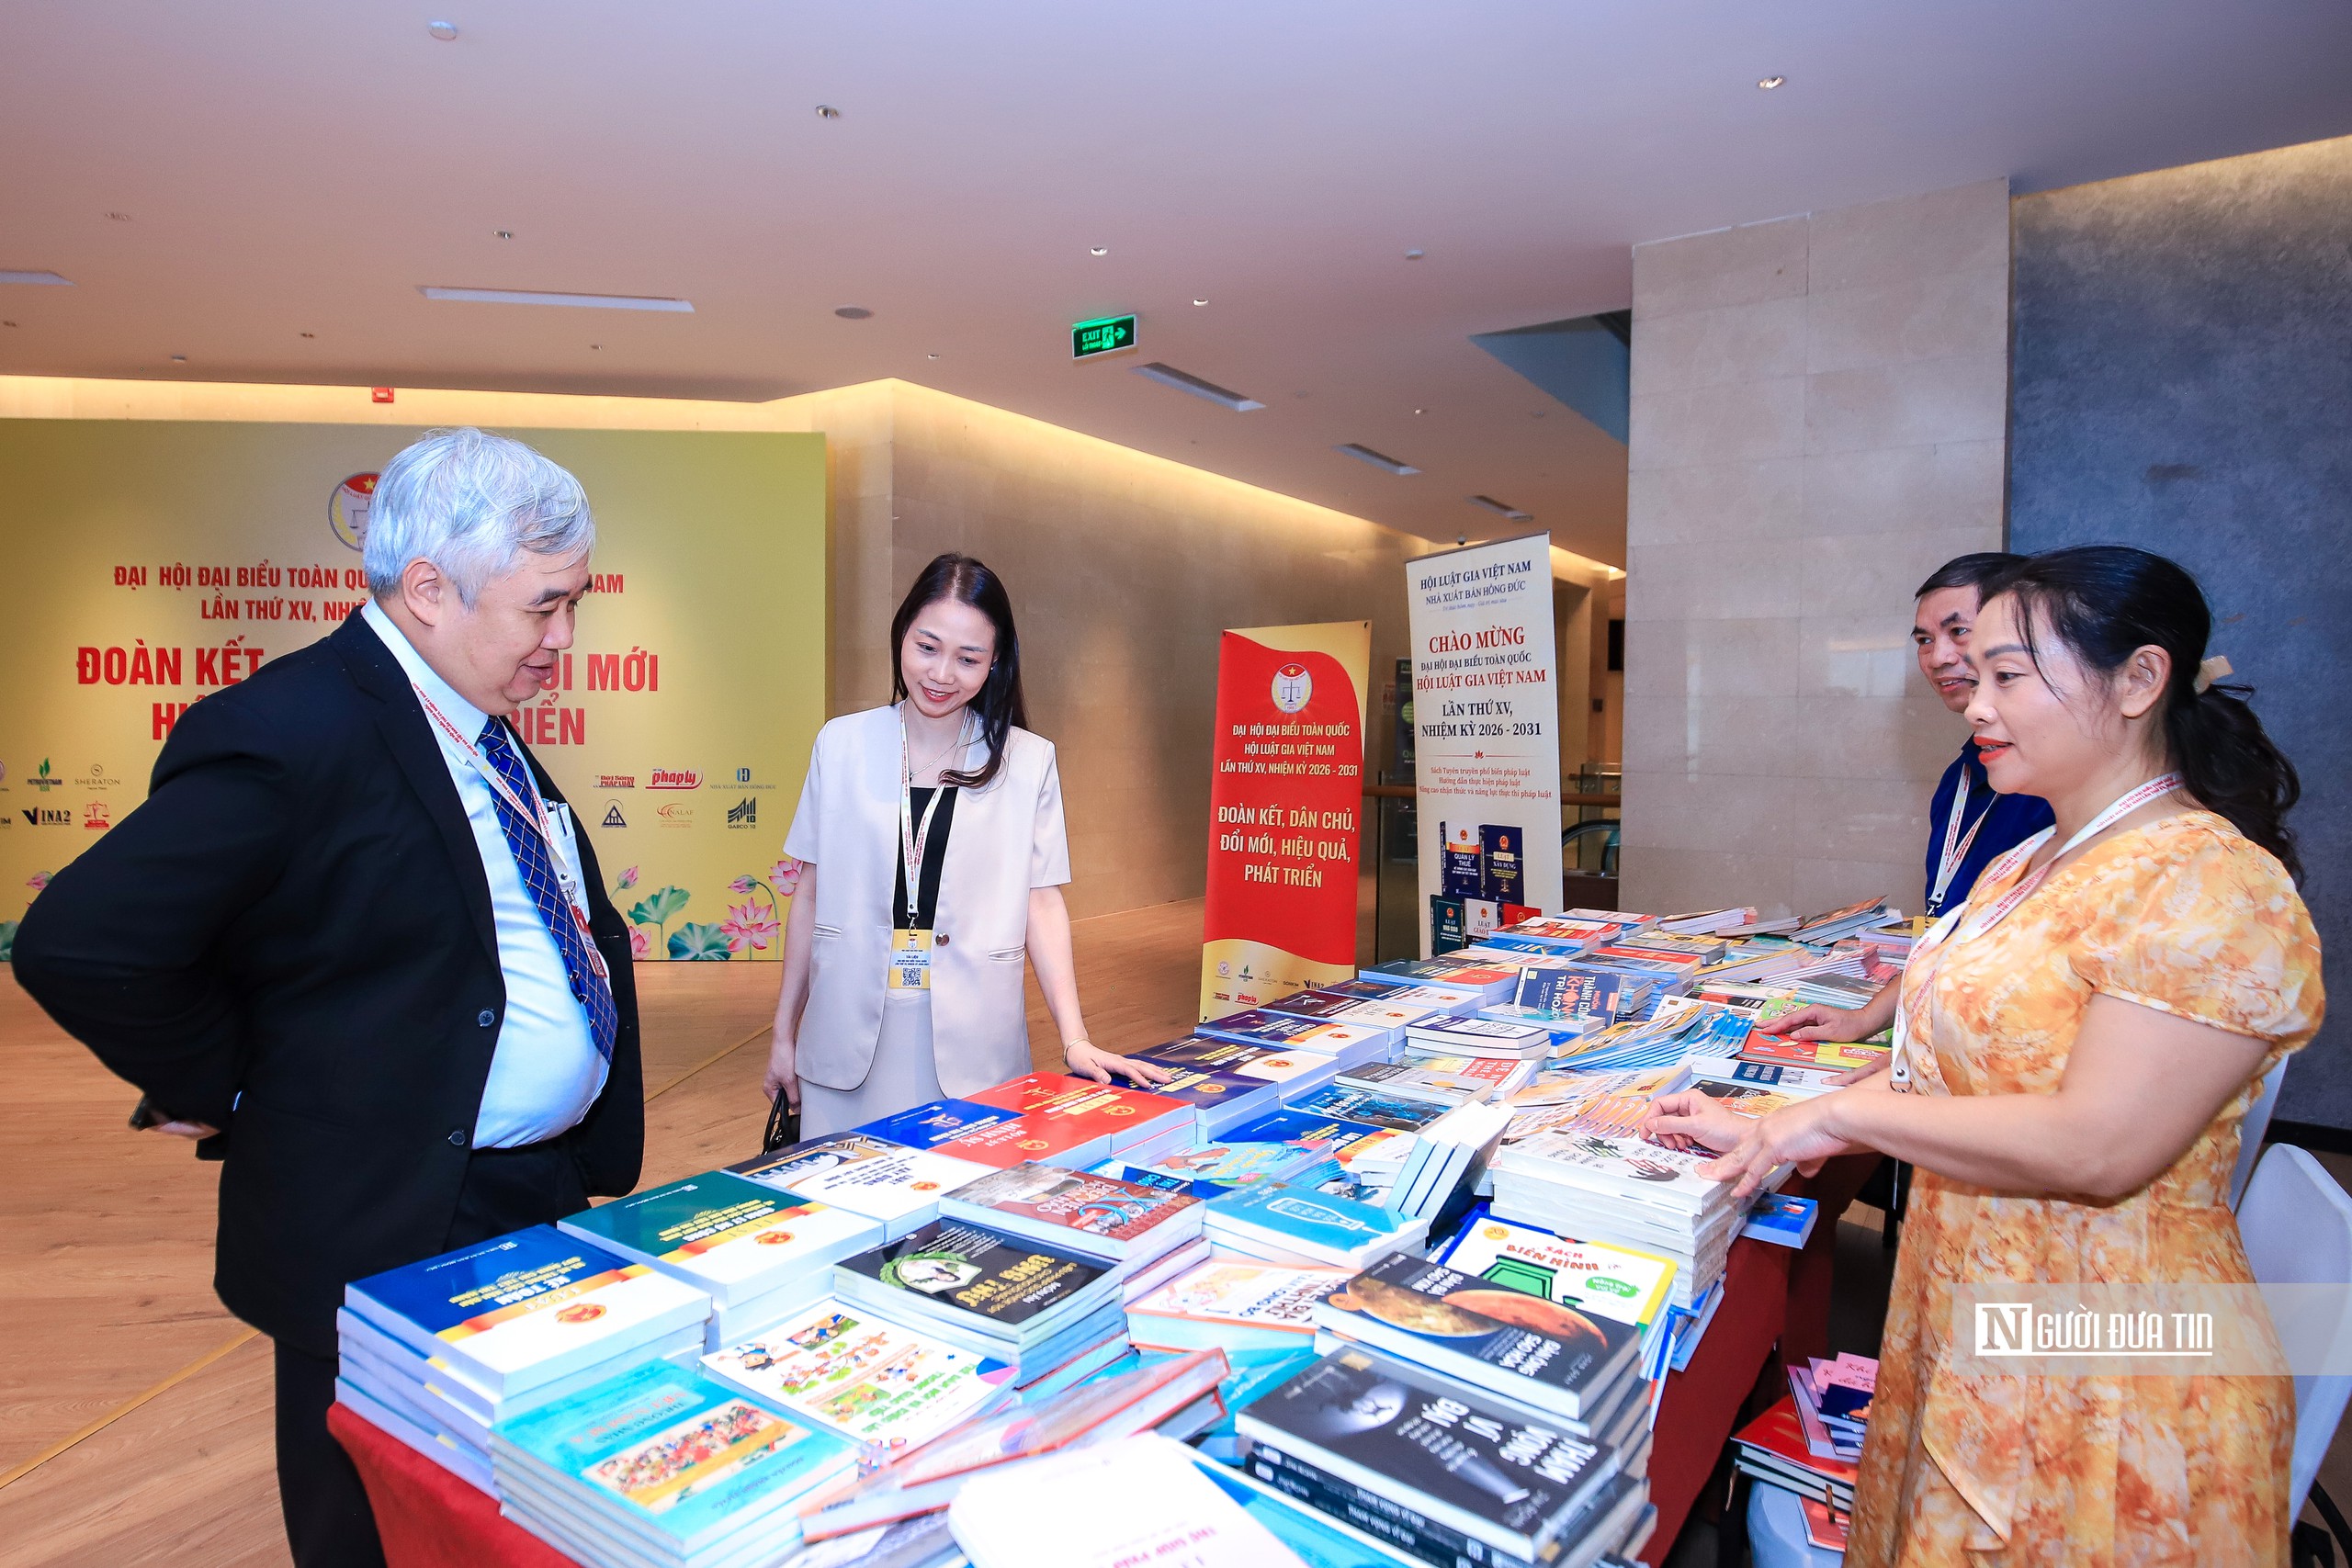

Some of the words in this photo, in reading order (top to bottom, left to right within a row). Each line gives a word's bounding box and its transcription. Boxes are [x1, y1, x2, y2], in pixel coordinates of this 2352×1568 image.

[1082, 330, 1101, 342] EXIT
[114, 566, 146, 589] ĐẠI
[159, 562, 190, 591] HỘI
[198, 567, 229, 591] ĐẠI
[237, 559, 280, 586] BIỂU
[288, 564, 337, 588] TOÀN
[345, 569, 368, 589] QU
[1420, 575, 1436, 591] HỘI
[1439, 572, 1461, 587] LUẬT
[1464, 570, 1480, 582] GIA
[1483, 564, 1504, 580] VIỆT
[1508, 559, 1531, 572] NAM
[1426, 592, 1441, 604] NHÀ
[1442, 589, 1462, 603] XUẤT
[1464, 587, 1481, 599] BẢN
[1483, 582, 1506, 596] HỒNG
[1508, 580, 1525, 592] ĐỨC
[200, 592, 238, 619] LẦN
[245, 597, 283, 620] THỨ
[288, 601, 316, 623] XV,
[1430, 629, 1471, 653] CHÀO
[1476, 626, 1524, 649] MỪNG
[76, 639, 181, 685] ĐOÀN
[196, 636, 264, 685] KẾT
[587, 647, 658, 691] MỚI
[1421, 660, 1432, 671] ĐẠI
[1434, 658, 1447, 671] HỘI
[1449, 658, 1462, 670] ĐẠI
[1464, 654, 1482, 667] BIỂU
[1485, 653, 1505, 666] TOÀN
[1508, 651, 1532, 664] QUỐC
[1417, 674, 1433, 692] HỘI
[1436, 672, 1462, 691] LUẬT
[1464, 672, 1485, 687] GIA
[1487, 669, 1513, 688] VIỆT
[1516, 669, 1546, 683] NAM
[1442, 699, 1464, 716] LẦN
[1468, 699, 1493, 716] THỨ
[1496, 701, 1512, 716] XV,
[1233, 724, 1246, 738] ĐẠI
[1250, 721, 1264, 738] HỘI
[1266, 724, 1279, 738] ĐẠI
[1282, 720, 1300, 736] BIỂU
[1303, 721, 1324, 736] TOÀN
[1326, 720, 1350, 737] QUỐC
[1422, 723, 1456, 739] NHIỆM
[1460, 721, 1476, 737] KỲ
[1479, 723, 1503, 736] 2026
[1513, 722, 1541, 735] 2031
[1245, 741, 1259, 756] HỘI
[1261, 741, 1279, 757] LUẬT
[1282, 743, 1295, 755] GIA
[1296, 742, 1314, 758] VIỆT
[1316, 744, 1334, 756] NAM
[1220, 759, 1236, 773] LẦN
[1238, 759, 1253, 774] THỨ
[1254, 763, 1266, 776] XV,
[1269, 762, 1295, 776] NHIỆM
[1296, 761, 1306, 775] KỲ
[1309, 764, 1330, 775] 2026
[1338, 765, 1358, 776] 2031
[1504, 768, 1517, 776] pháp
[1519, 768, 1530, 776] luật
[1496, 778, 1508, 787] pháp
[1510, 778, 1521, 787] luật
[1521, 791, 1536, 799] pháp
[1537, 790, 1552, 798] luật
[1218, 805, 1255, 825] ĐOÀN
[1259, 804, 1285, 829] KẾT,
[1290, 806, 1317, 828] DÂN
[1322, 807, 1355, 832] CHỦ,
[1220, 829, 1244, 852] ĐỔI
[1248, 833, 1277, 858] MỚI,
[1281, 835, 1313, 861] HIỆU
[1317, 837, 1351, 863] QUẢ,
[1245, 862, 1280, 884] PHÁT
[1283, 863, 1321, 887] TRIỂN
[1555, 976, 1566, 991] TRÌ
[1580, 976, 1597, 998] THÀNH
[1591, 990, 1602, 1010] MUỐN
[543, 1275, 571, 1290] KẾ
[1430, 1266, 1451, 1280] SAO
[494, 1285, 547, 1304] TOÁN
[1411, 1277, 1434, 1292] KIM
[1516, 1333, 1542, 1354] SAO
[1518, 1354, 1548, 1377] ÔNG
[1421, 1397, 1470, 1428] ĐẠI
[1463, 1416, 1503, 1443] VĨ
[1498, 1425, 1557, 1467] VỌNG
[1533, 1438, 1598, 1484] THAM
